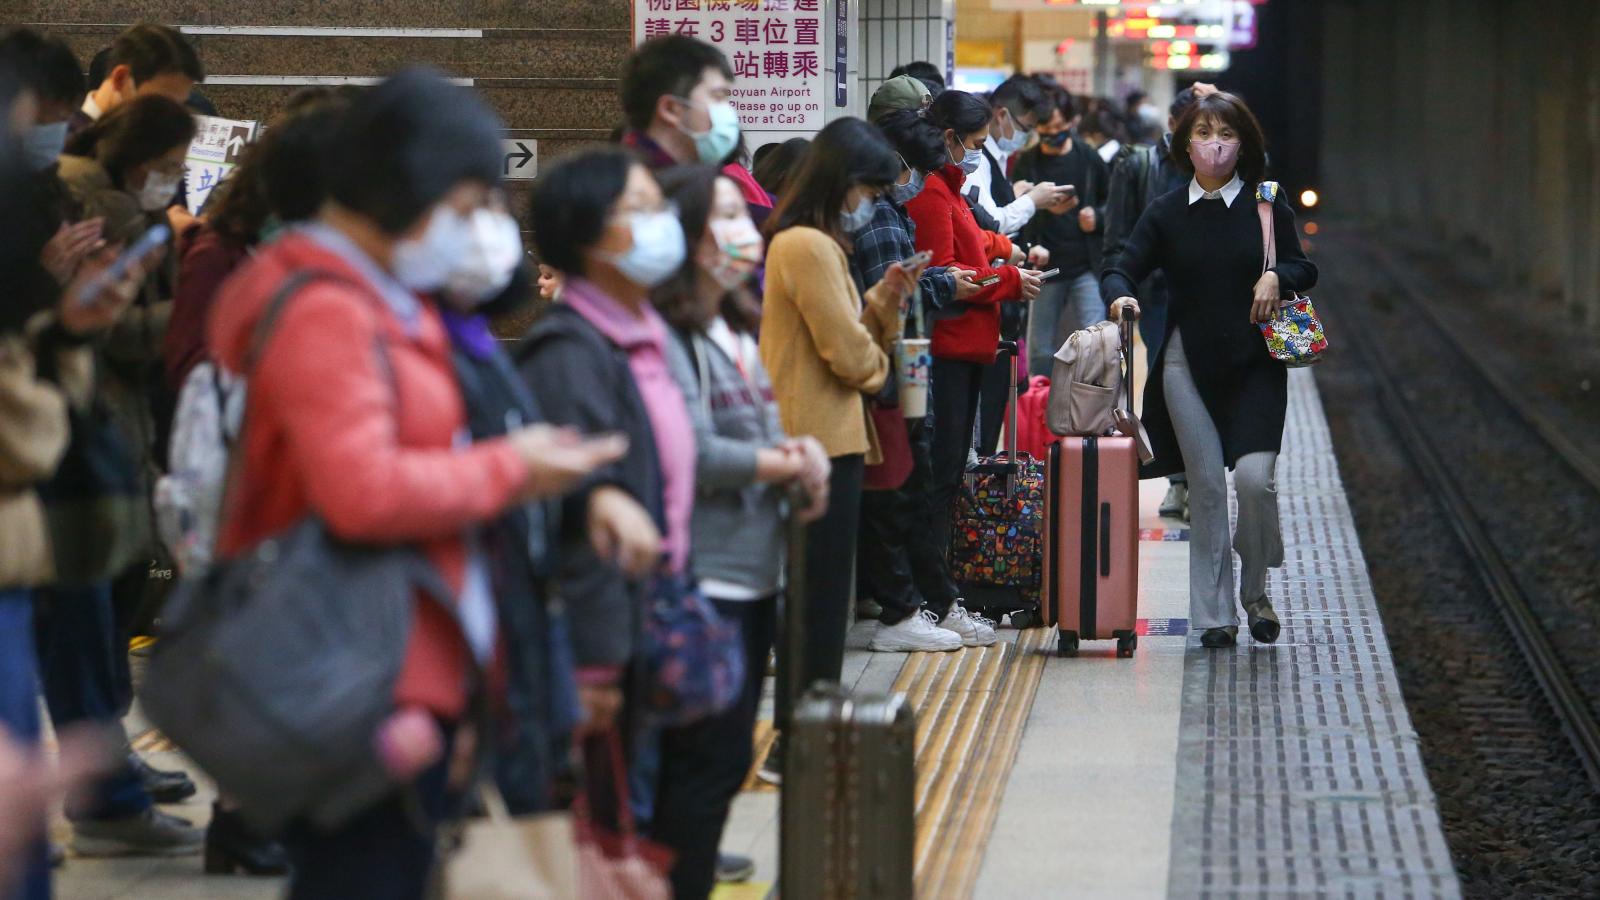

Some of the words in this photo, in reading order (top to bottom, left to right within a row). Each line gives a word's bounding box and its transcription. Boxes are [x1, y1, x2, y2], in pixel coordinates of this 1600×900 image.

[727, 89, 766, 98] aoyuan
[770, 87, 811, 97] Airport
[769, 103, 784, 112] go
[787, 103, 801, 112] up
[777, 113, 805, 123] Car3
